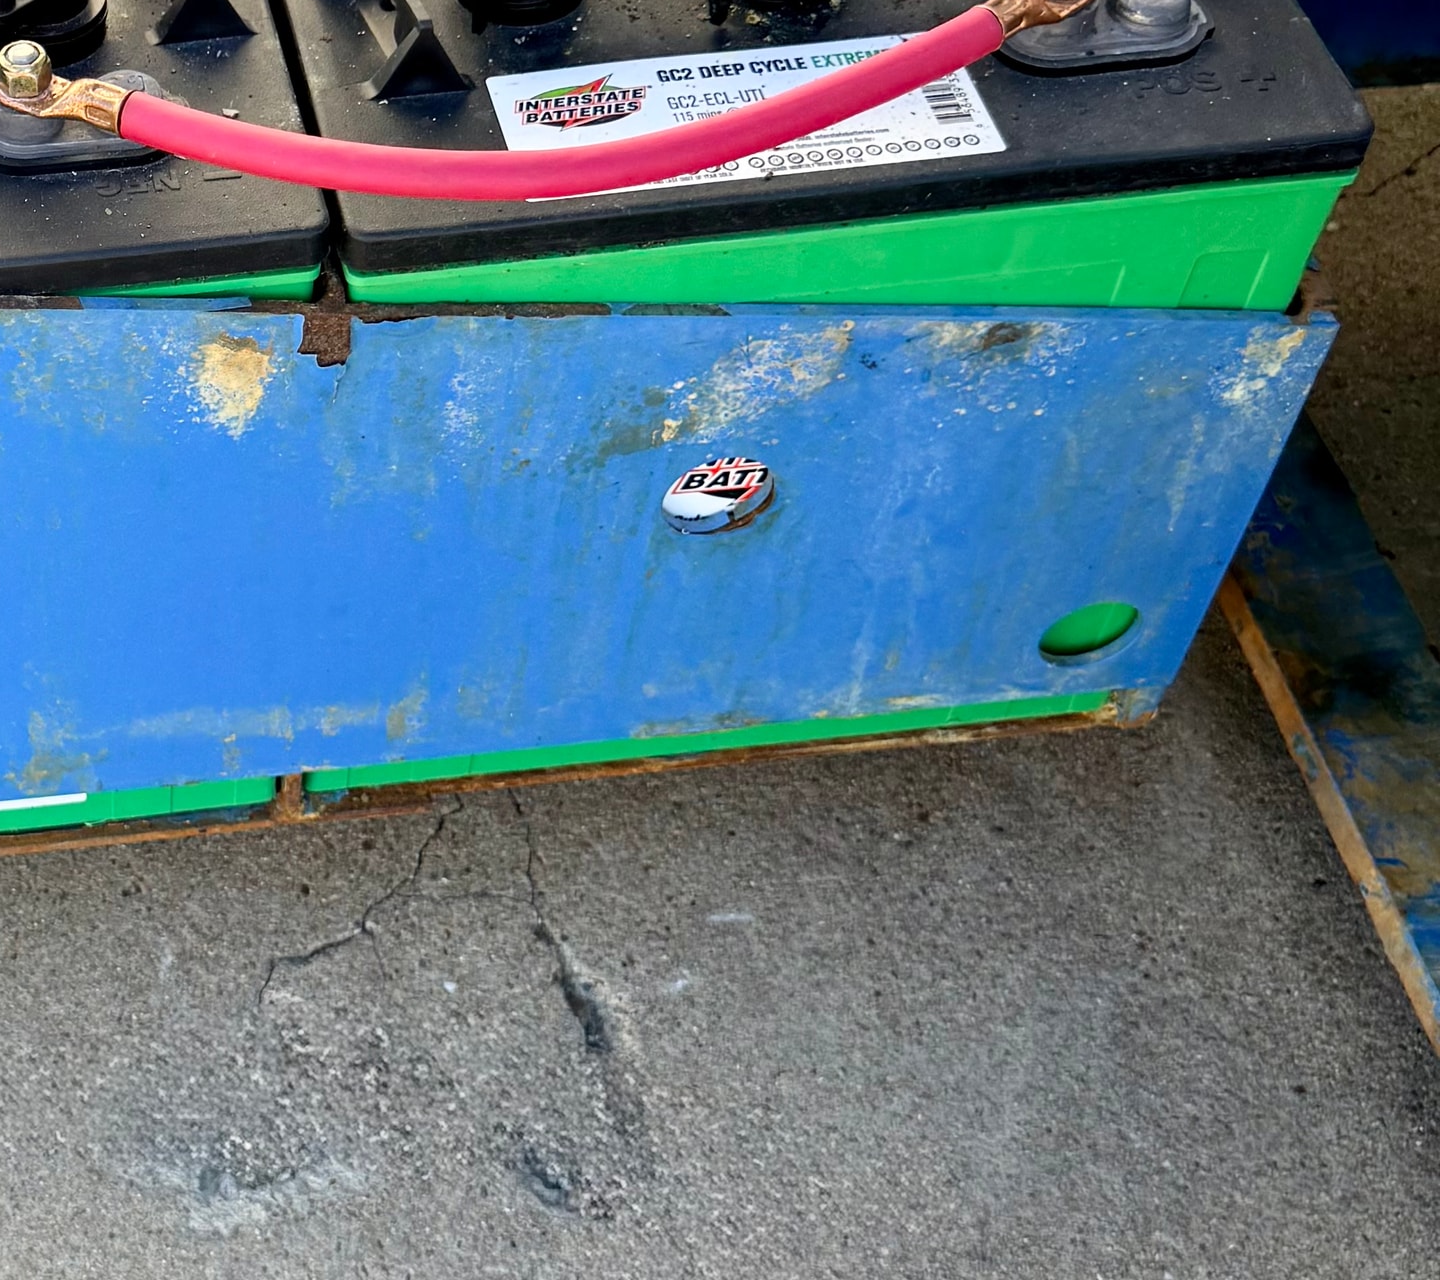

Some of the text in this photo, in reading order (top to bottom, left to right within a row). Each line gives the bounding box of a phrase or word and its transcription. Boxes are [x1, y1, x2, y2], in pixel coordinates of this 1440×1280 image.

[657, 68, 694, 83] GC2
[699, 63, 745, 79] DEEP
[748, 57, 808, 74] CYCLE
[517, 87, 645, 113] INTERSTATE
[525, 101, 641, 124] BATTERIES
[671, 110, 695, 123] 115
[95, 173, 182, 198] NEG
